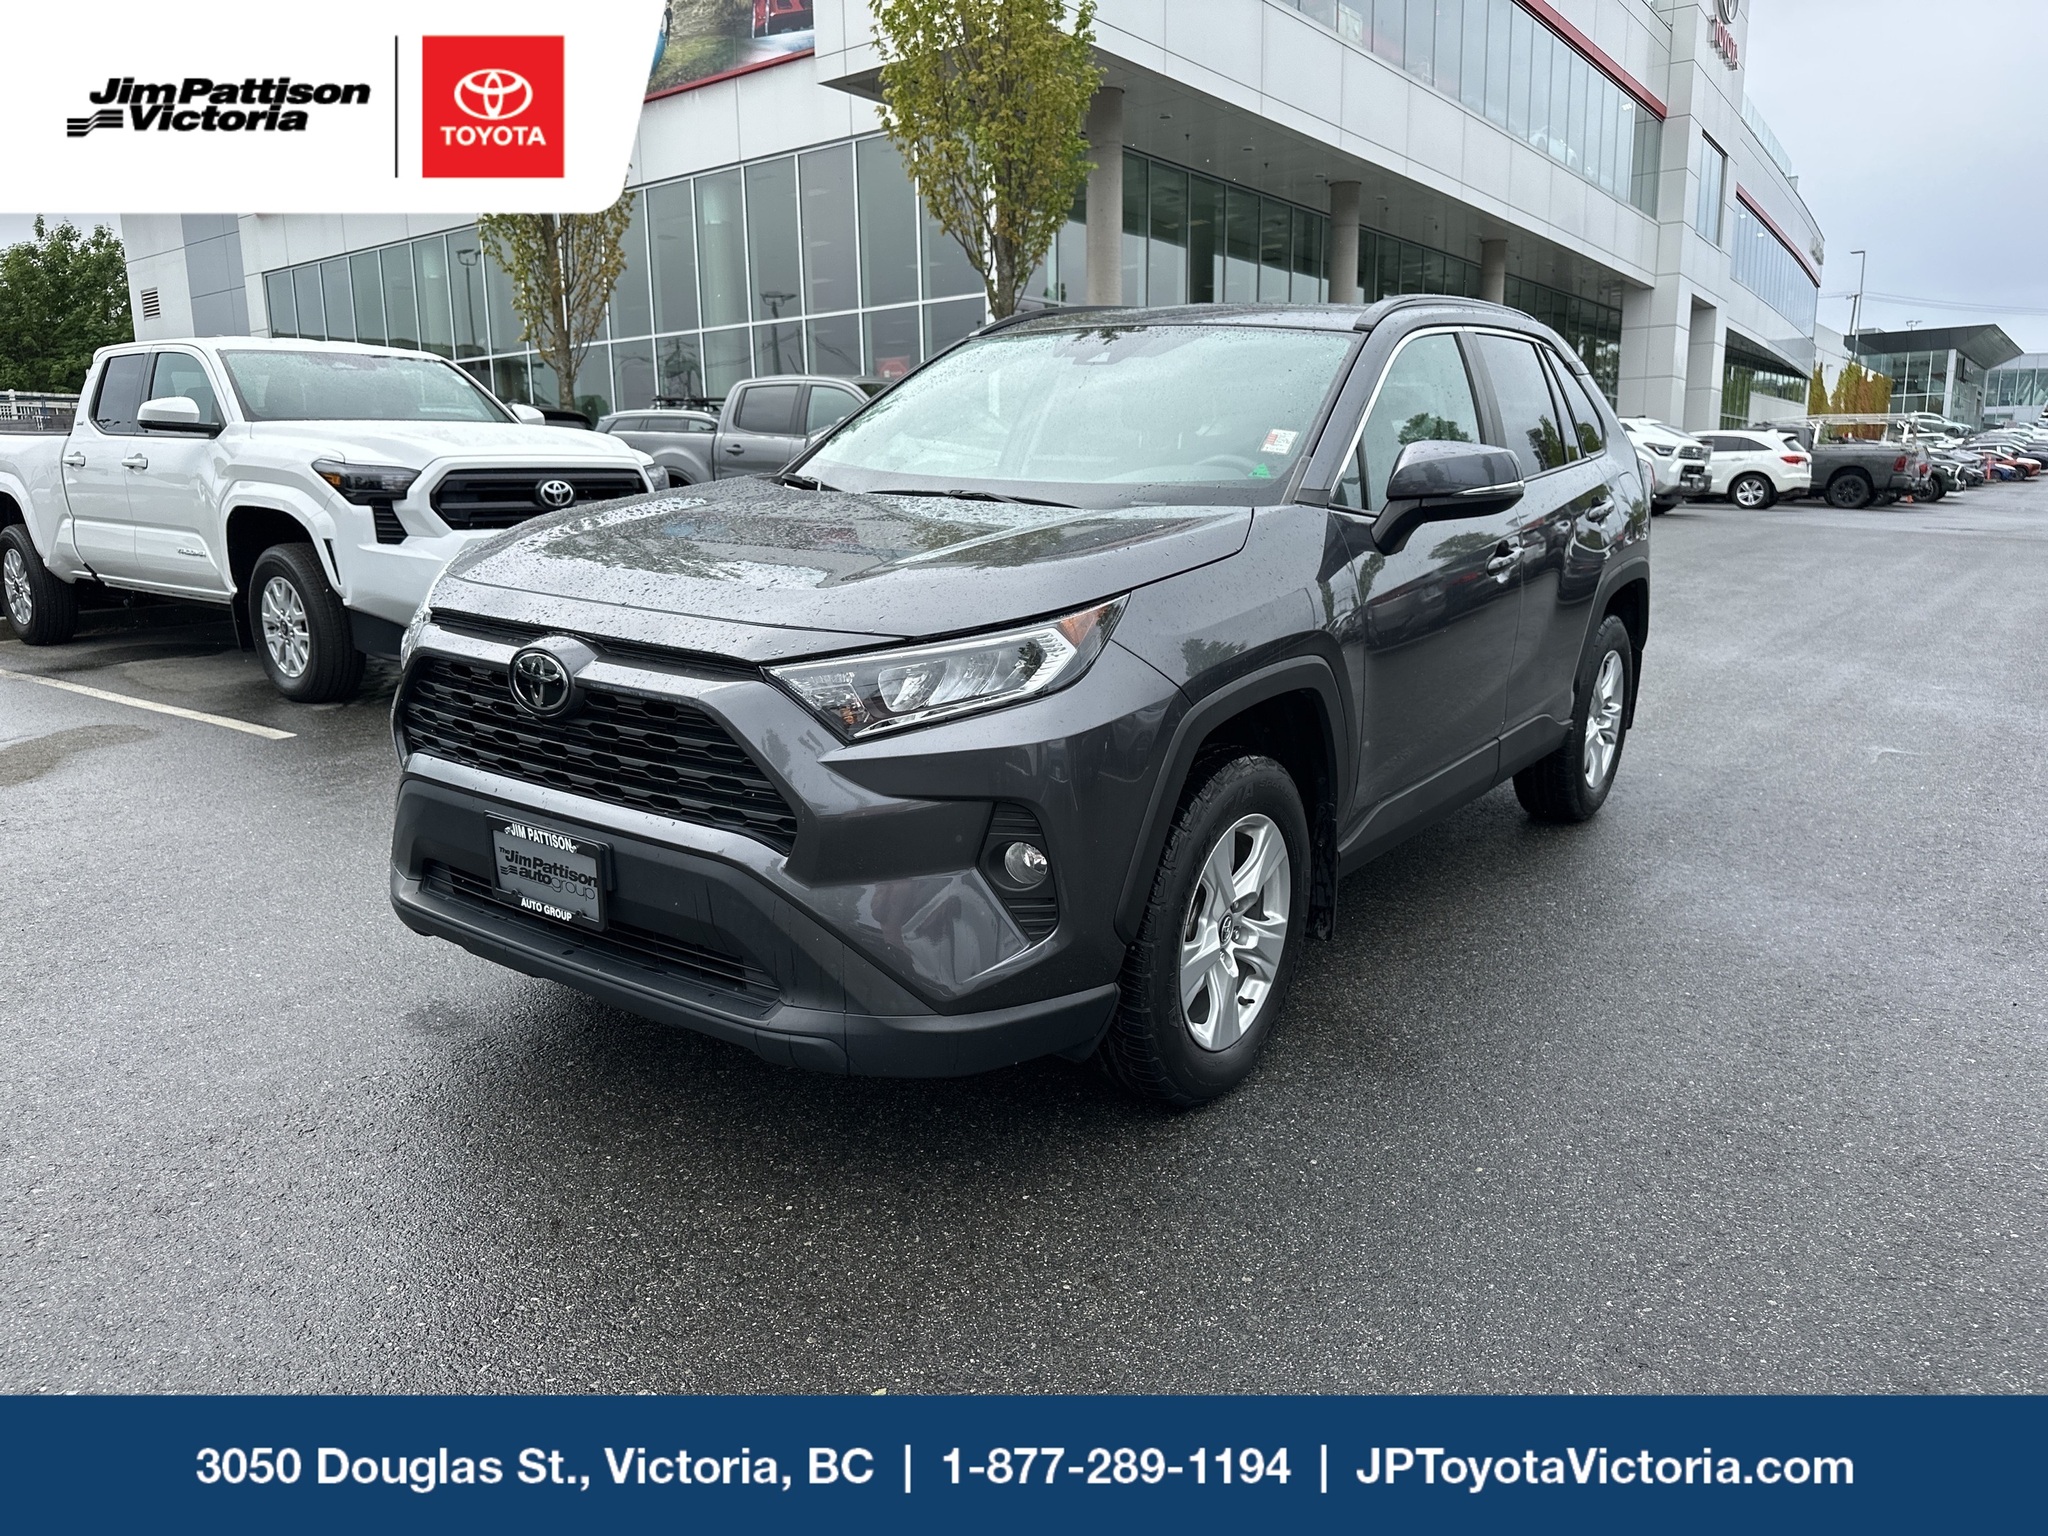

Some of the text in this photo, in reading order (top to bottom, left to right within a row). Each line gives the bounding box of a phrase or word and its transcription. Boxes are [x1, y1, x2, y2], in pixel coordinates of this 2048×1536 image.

[511, 823, 573, 852] JIM PATTISON
[521, 897, 573, 922] AUTO GROUP
